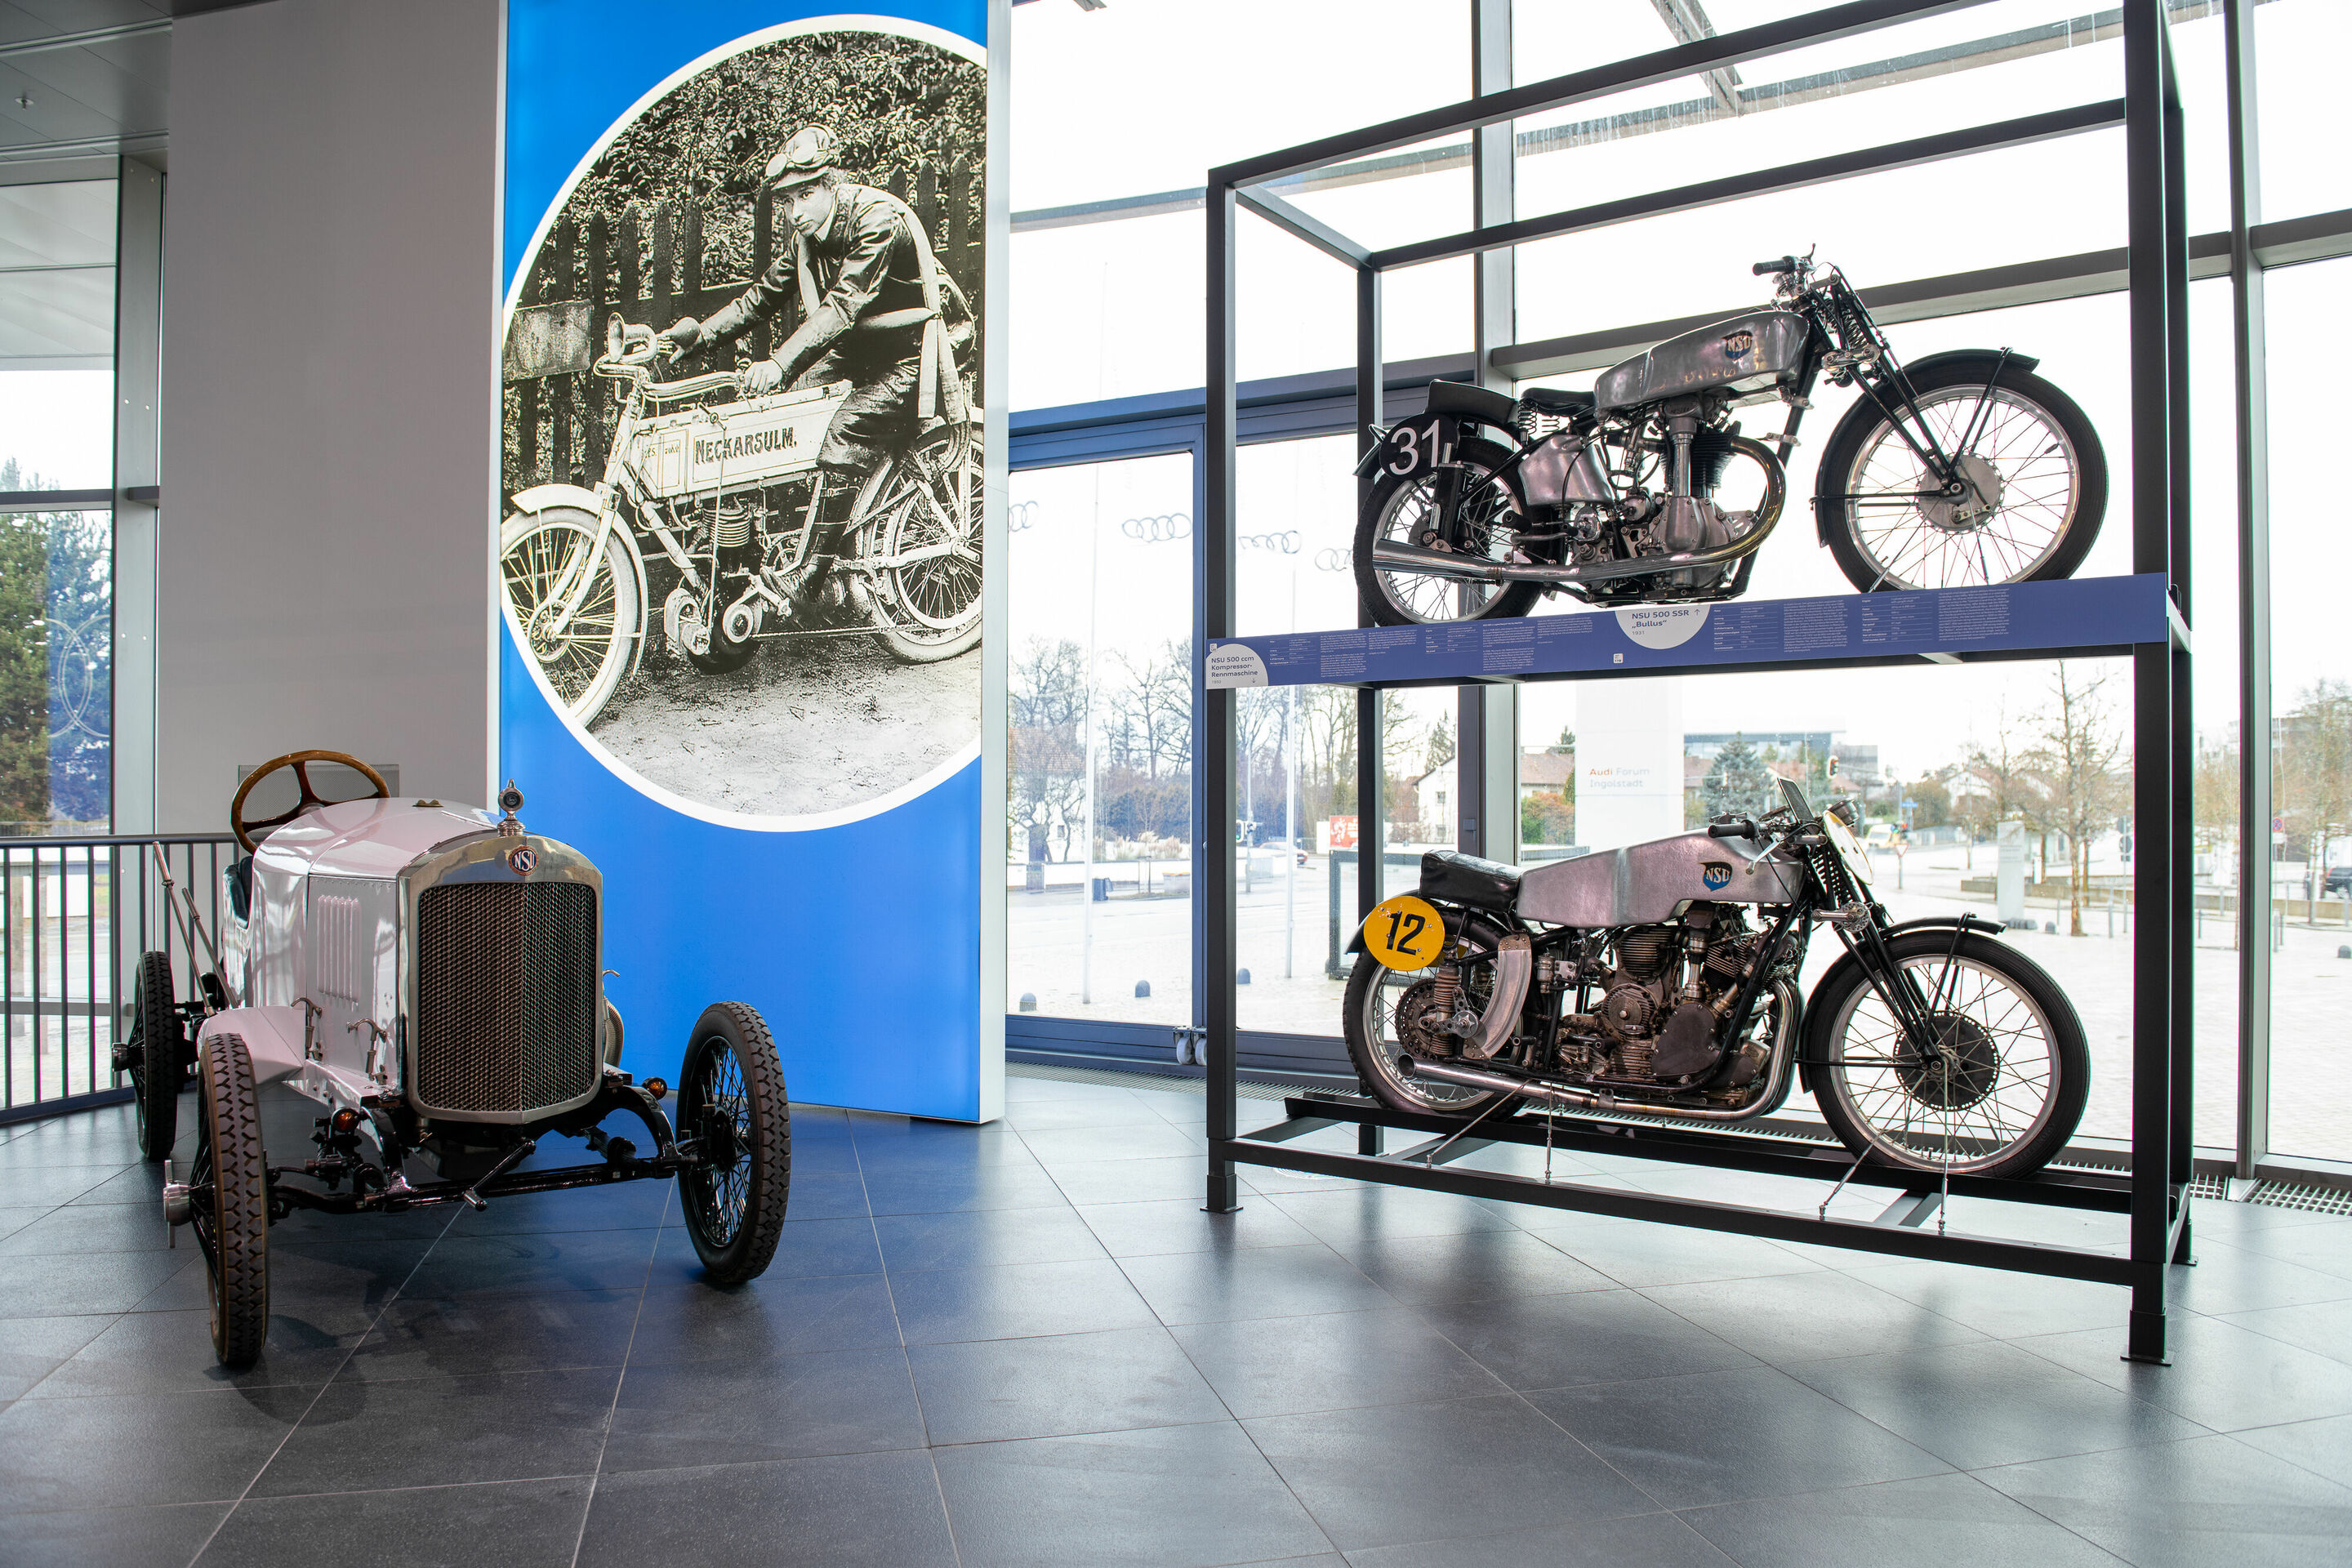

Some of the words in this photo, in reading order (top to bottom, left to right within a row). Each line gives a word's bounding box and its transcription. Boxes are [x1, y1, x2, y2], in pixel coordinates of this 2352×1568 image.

[1727, 335, 1753, 352] NSU
[1389, 419, 1440, 474] 31
[1589, 768, 1613, 776] Audi
[1590, 779, 1643, 789] Ingolstadt
[514, 850, 536, 871] NSU
[1706, 867, 1731, 884] NSU
[1386, 911, 1426, 956] 12
